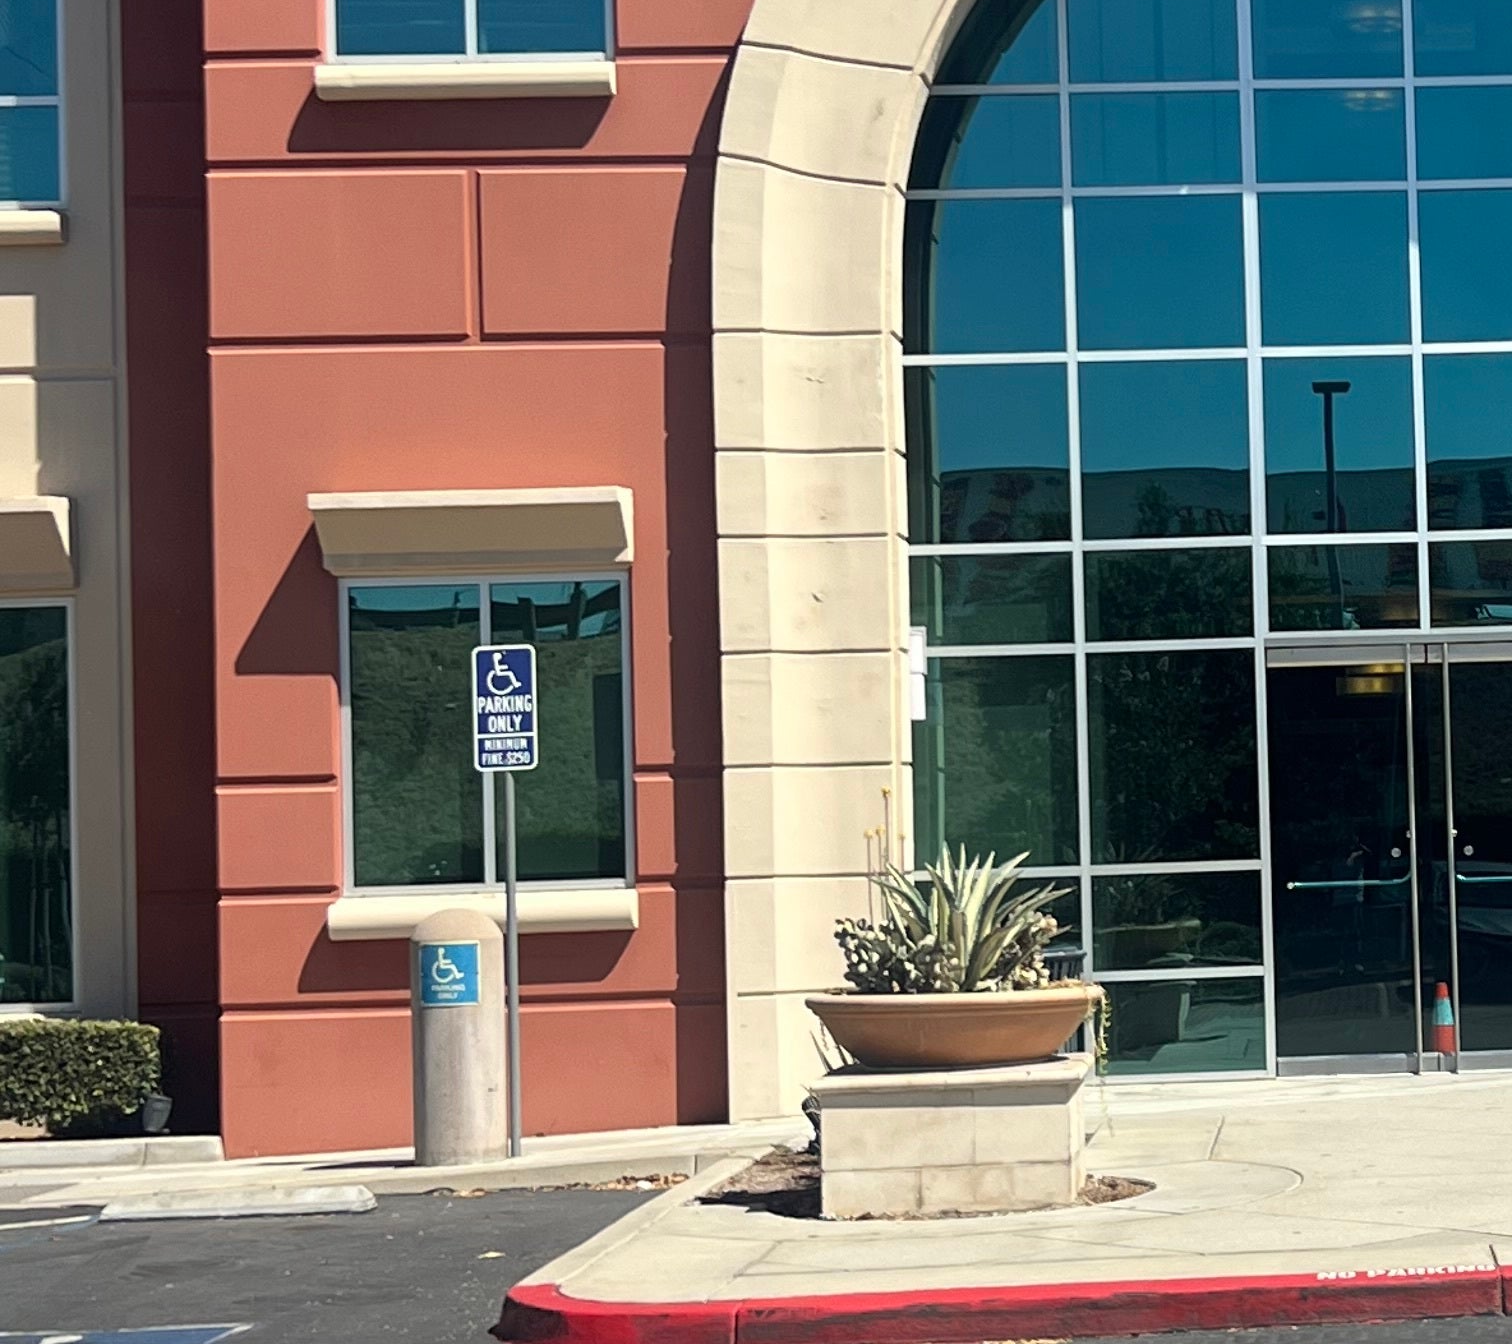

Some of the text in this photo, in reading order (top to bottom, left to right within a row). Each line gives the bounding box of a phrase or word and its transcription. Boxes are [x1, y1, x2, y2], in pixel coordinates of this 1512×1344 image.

[478, 695, 532, 714] PARKING
[488, 714, 522, 732] ONLY
[485, 738, 527, 751] MINIMUM
[482, 752, 503, 765] FINE
